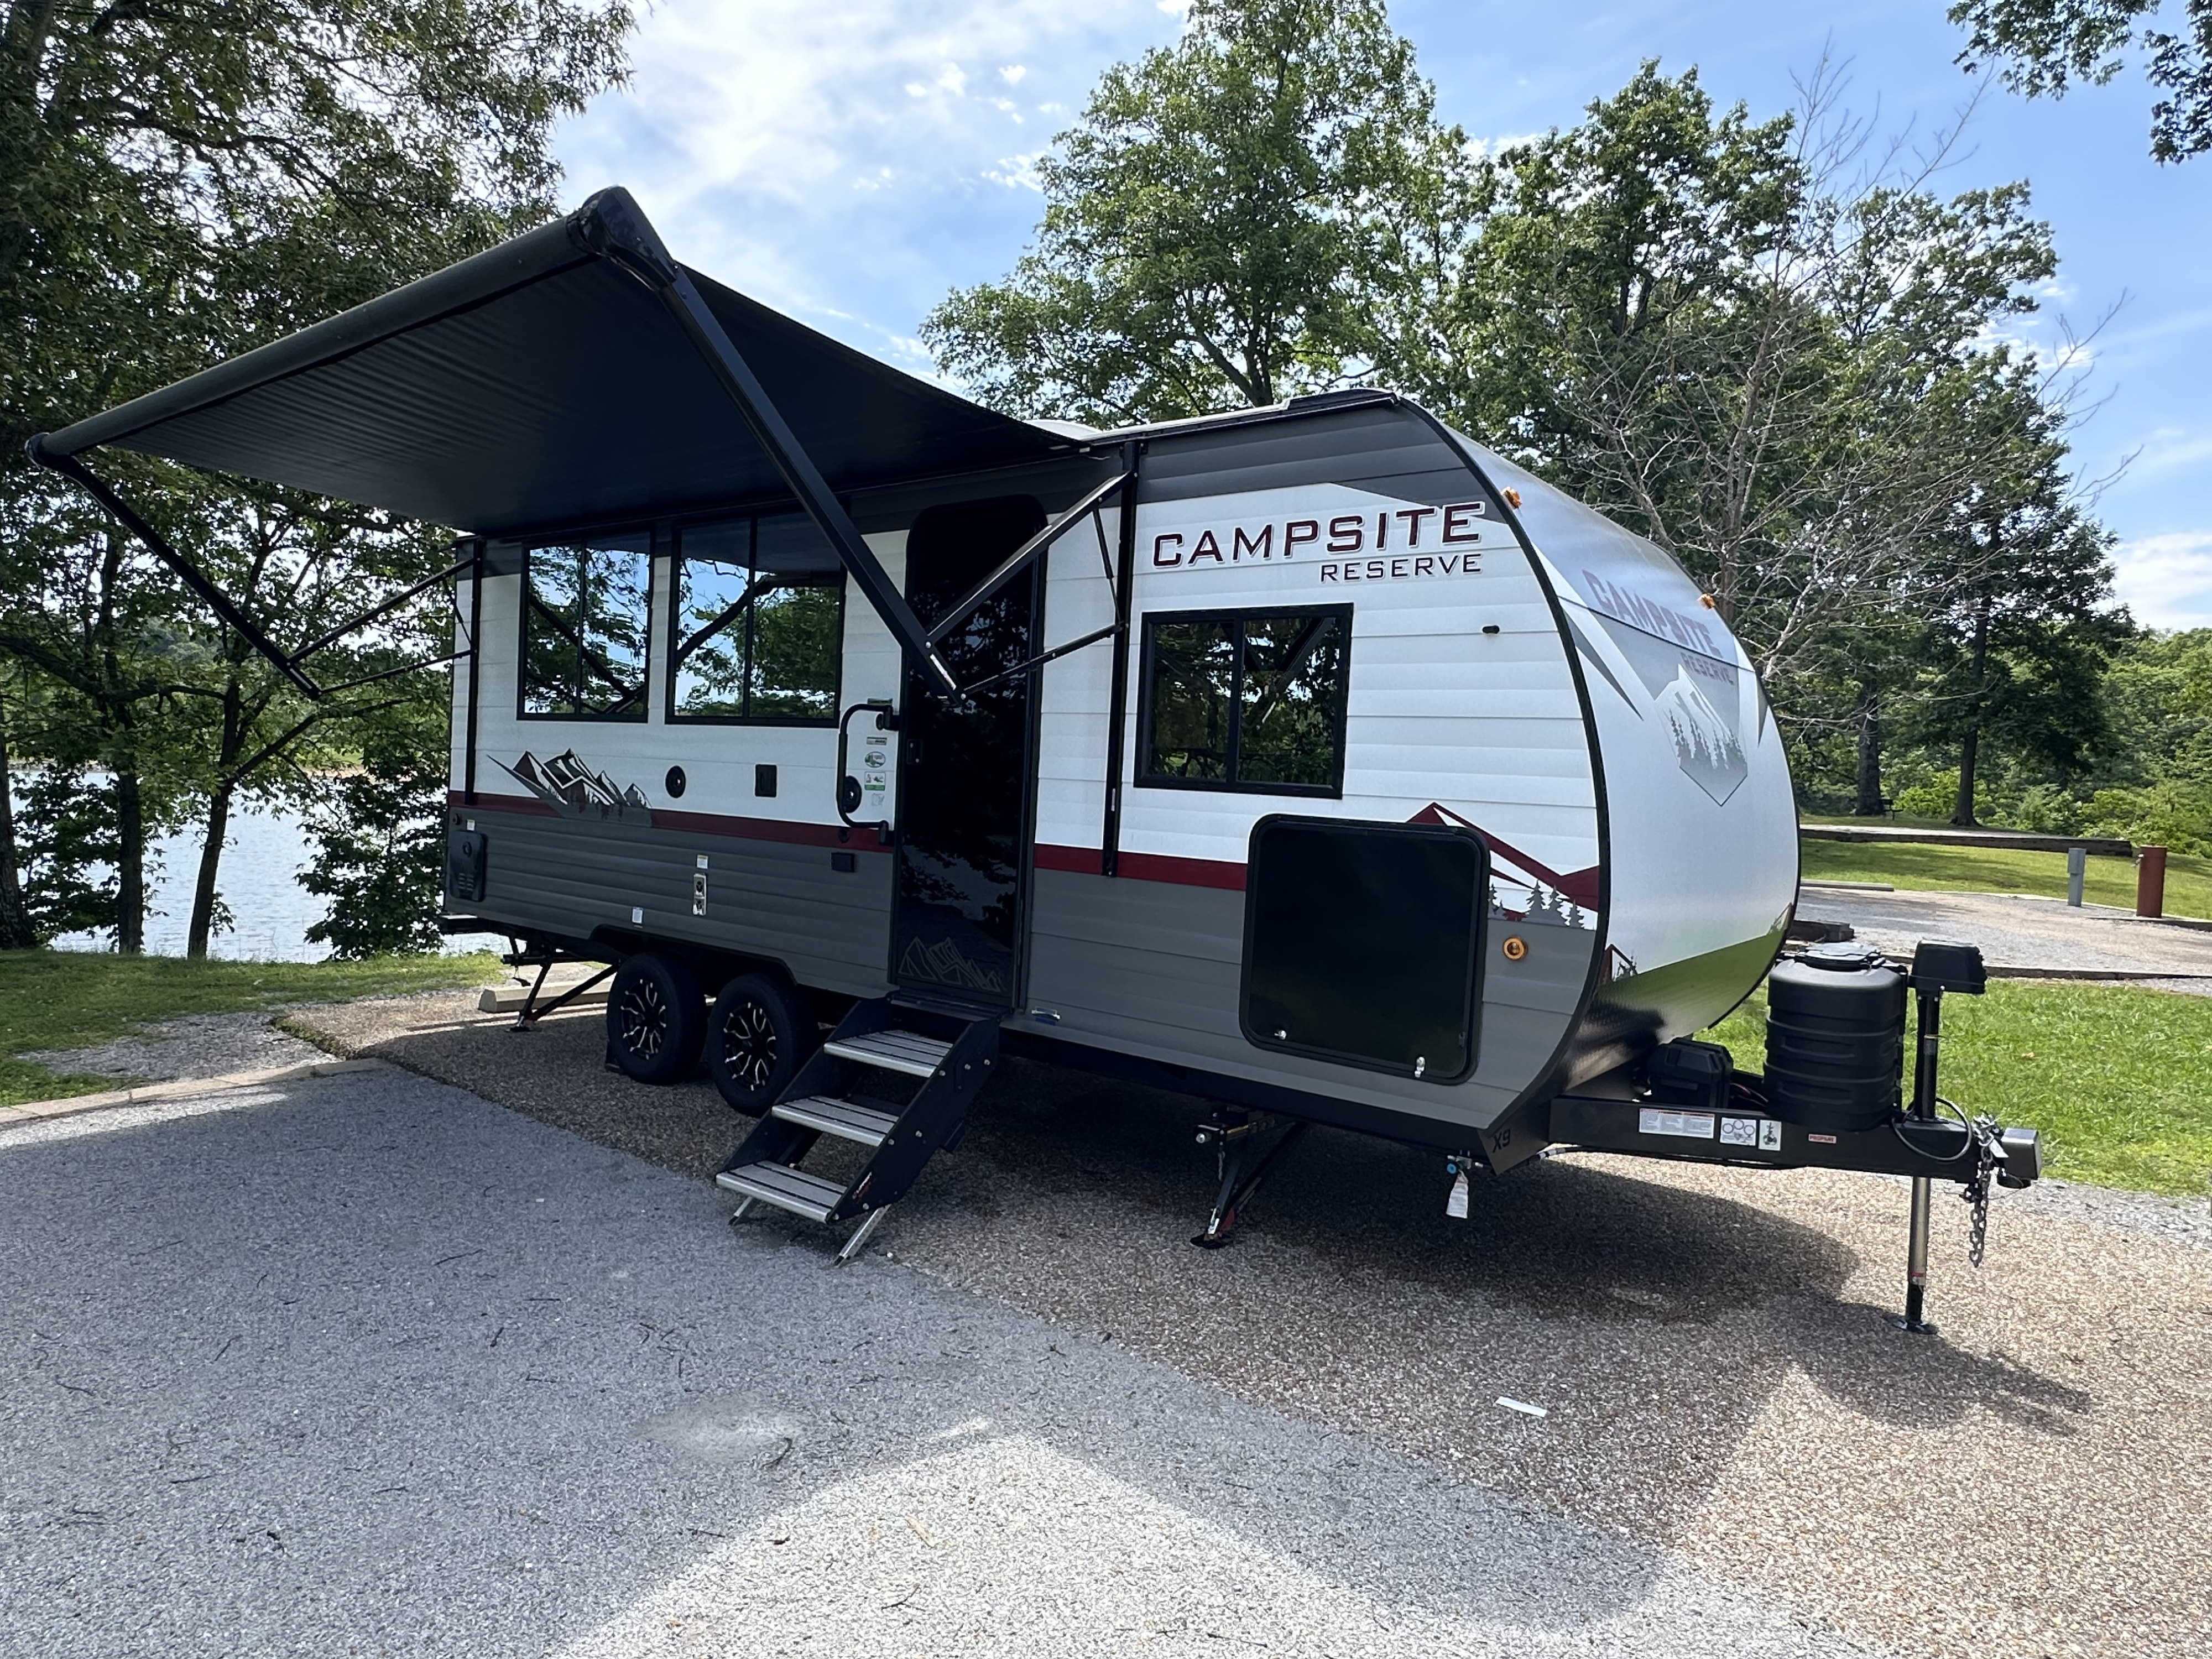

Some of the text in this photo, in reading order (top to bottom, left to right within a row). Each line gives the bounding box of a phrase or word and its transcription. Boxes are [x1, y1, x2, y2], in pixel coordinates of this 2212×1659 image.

[1153, 503, 1482, 567] CAMPSITE
[1321, 554, 1481, 582] RESERVE
[1582, 569, 1723, 659] CAMPSITE
[1680, 651, 1734, 685] RESERVE
